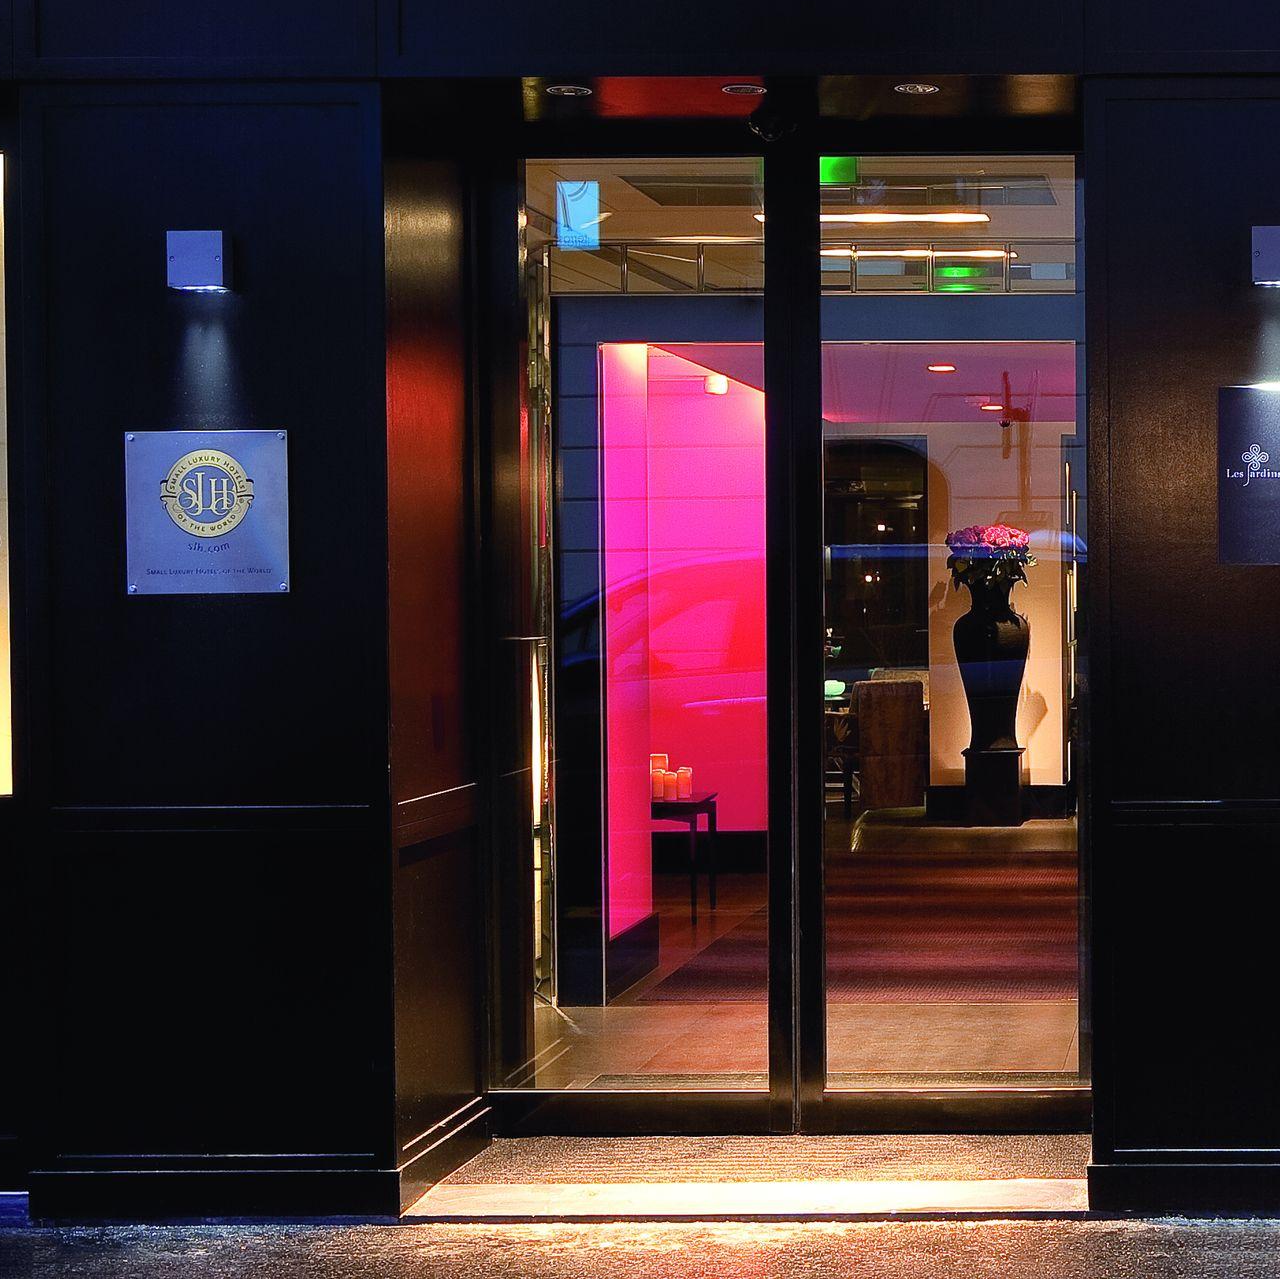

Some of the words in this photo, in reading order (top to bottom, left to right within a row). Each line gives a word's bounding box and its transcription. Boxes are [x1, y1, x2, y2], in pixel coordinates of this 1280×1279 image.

[169, 465, 188, 490] SMALL
[187, 456, 221, 466] LUXURY
[223, 461, 246, 490] HOTELS
[1226, 468, 1244, 478] Les
[177, 513, 188, 523] OF
[189, 523, 206, 532] THE
[209, 514, 237, 532] WORLD
[188, 542, 231, 553] slh.com
